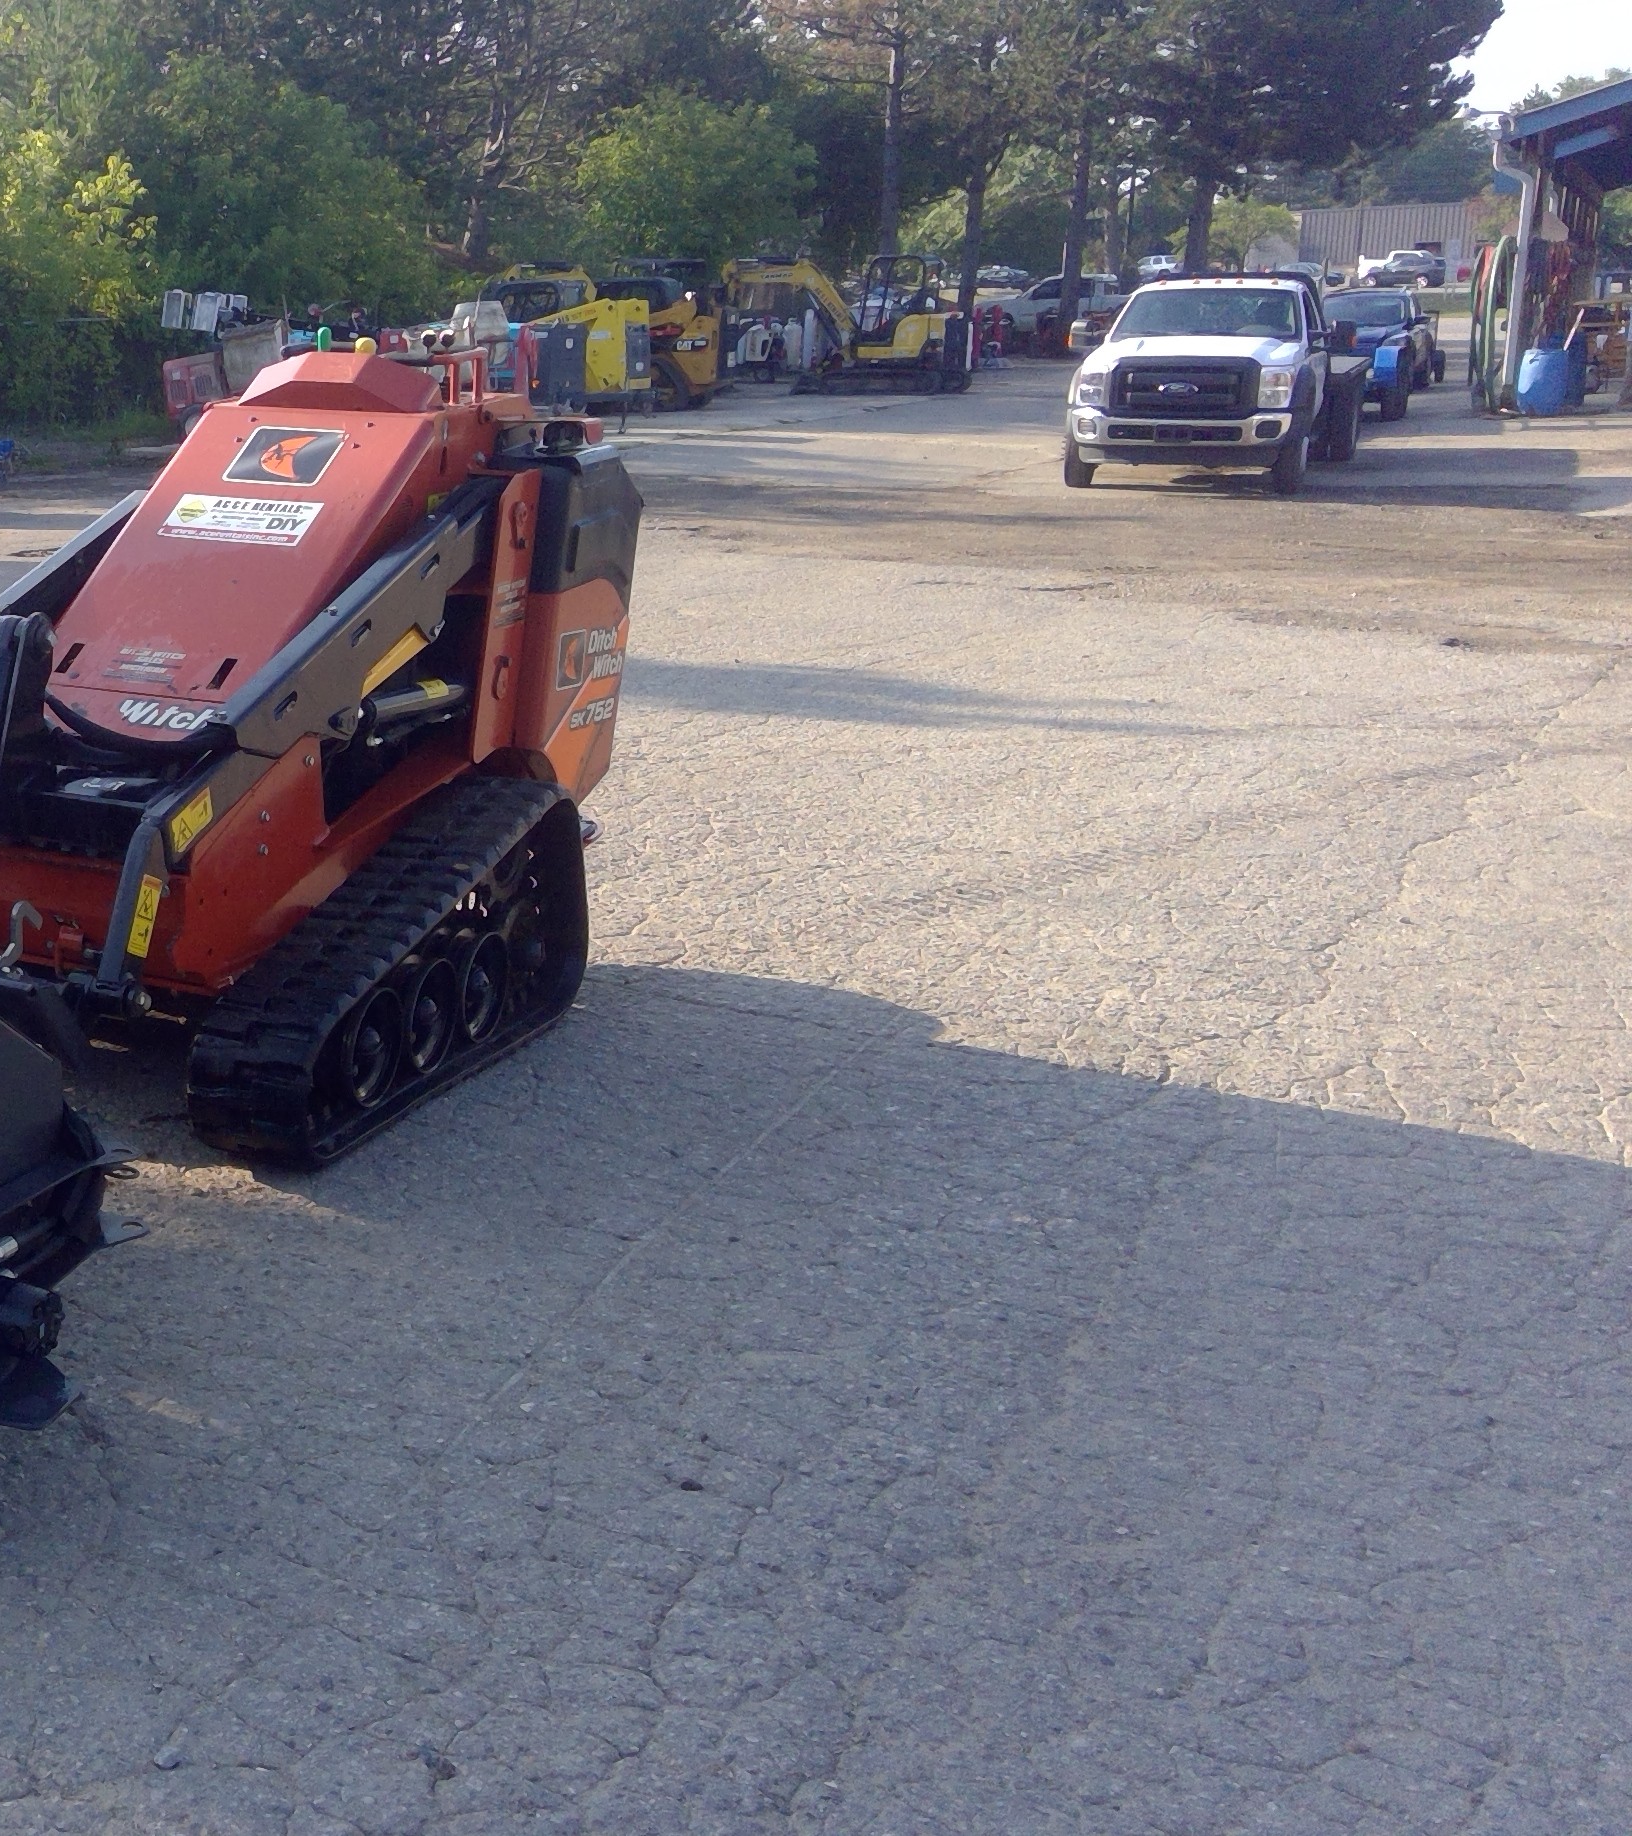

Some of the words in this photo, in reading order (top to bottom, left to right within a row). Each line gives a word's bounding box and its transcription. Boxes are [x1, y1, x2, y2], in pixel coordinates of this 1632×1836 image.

[676, 340, 693, 351] CAT
[265, 517, 308, 531] DIY
[587, 627, 617, 654] Ditch
[591, 652, 624, 679] Witch
[570, 697, 616, 729] SK752
